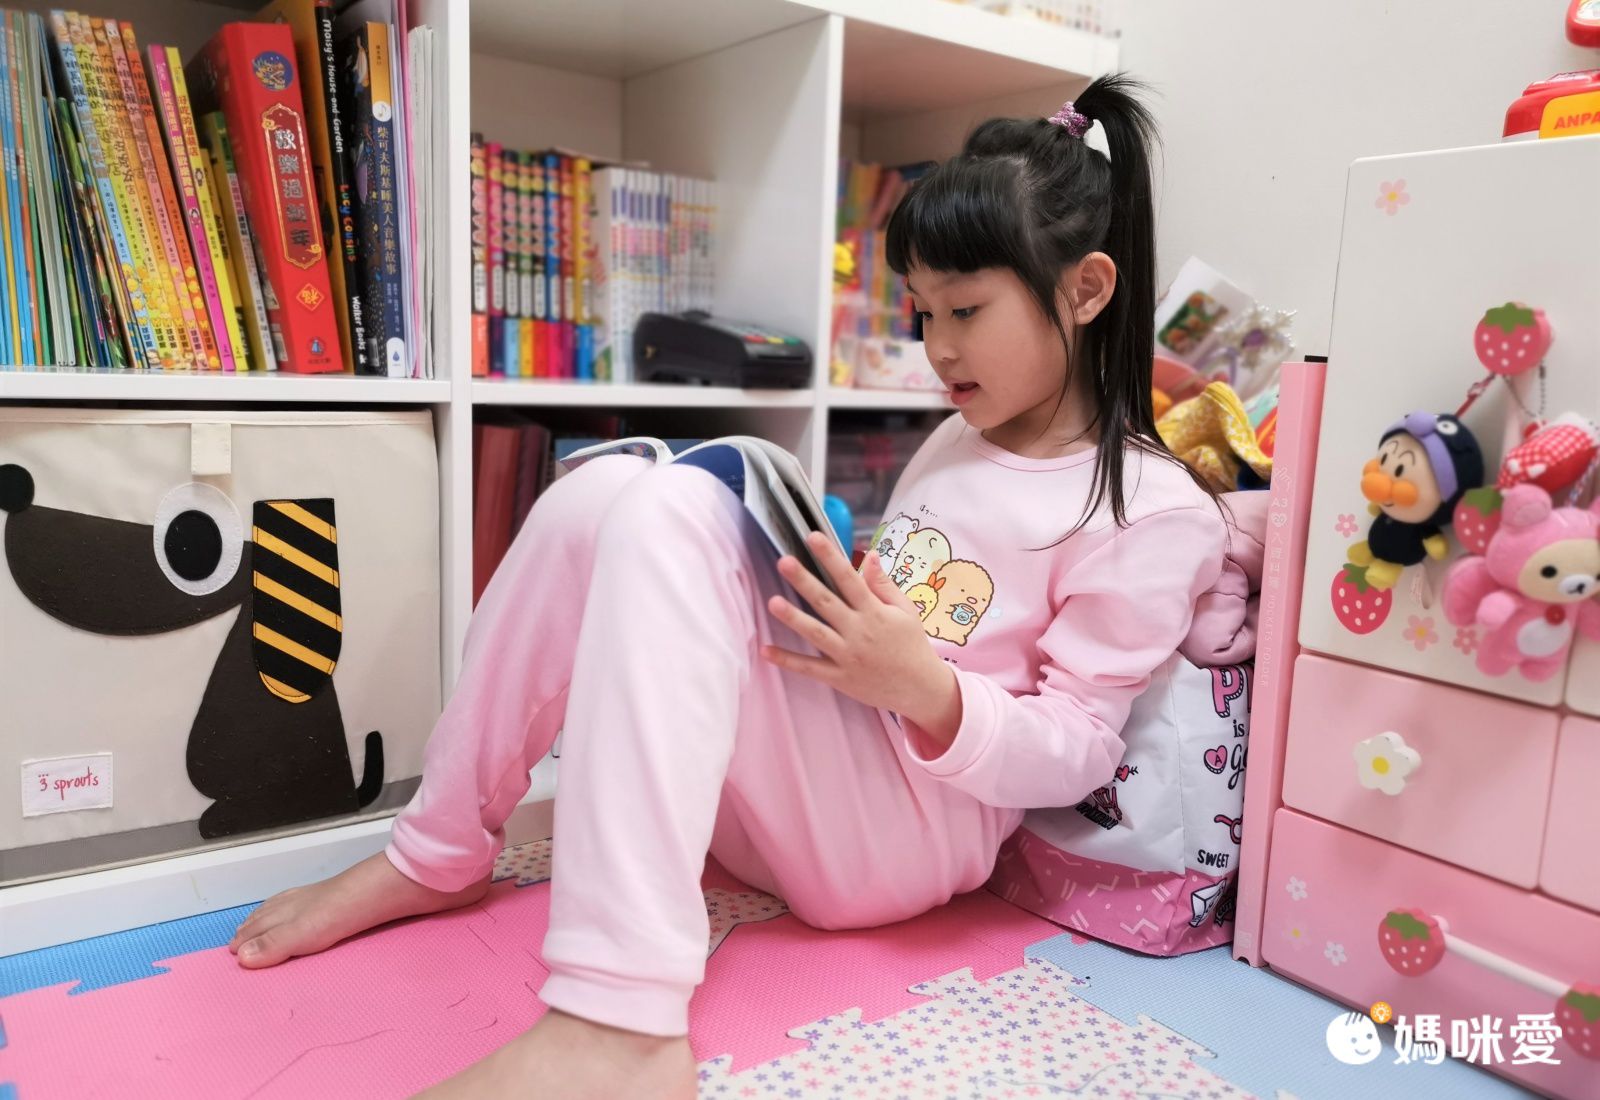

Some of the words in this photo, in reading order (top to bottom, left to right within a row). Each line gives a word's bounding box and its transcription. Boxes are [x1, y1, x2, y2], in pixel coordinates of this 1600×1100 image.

[322, 19, 335, 61] Maisy's
[327, 64, 337, 93] House
[331, 96, 339, 114] and
[332, 117, 344, 153] Garden
[339, 184, 351, 214] Lucy
[343, 216, 358, 264] Cousins
[352, 296, 363, 326] Walker
[356, 326, 367, 350] Books
[1271, 497, 1288, 508] A3
[1233, 719, 1245, 738] is
[1214, 754, 1222, 766] A
[53, 766, 99, 800] sprouts
[1197, 849, 1229, 868] SWEET
